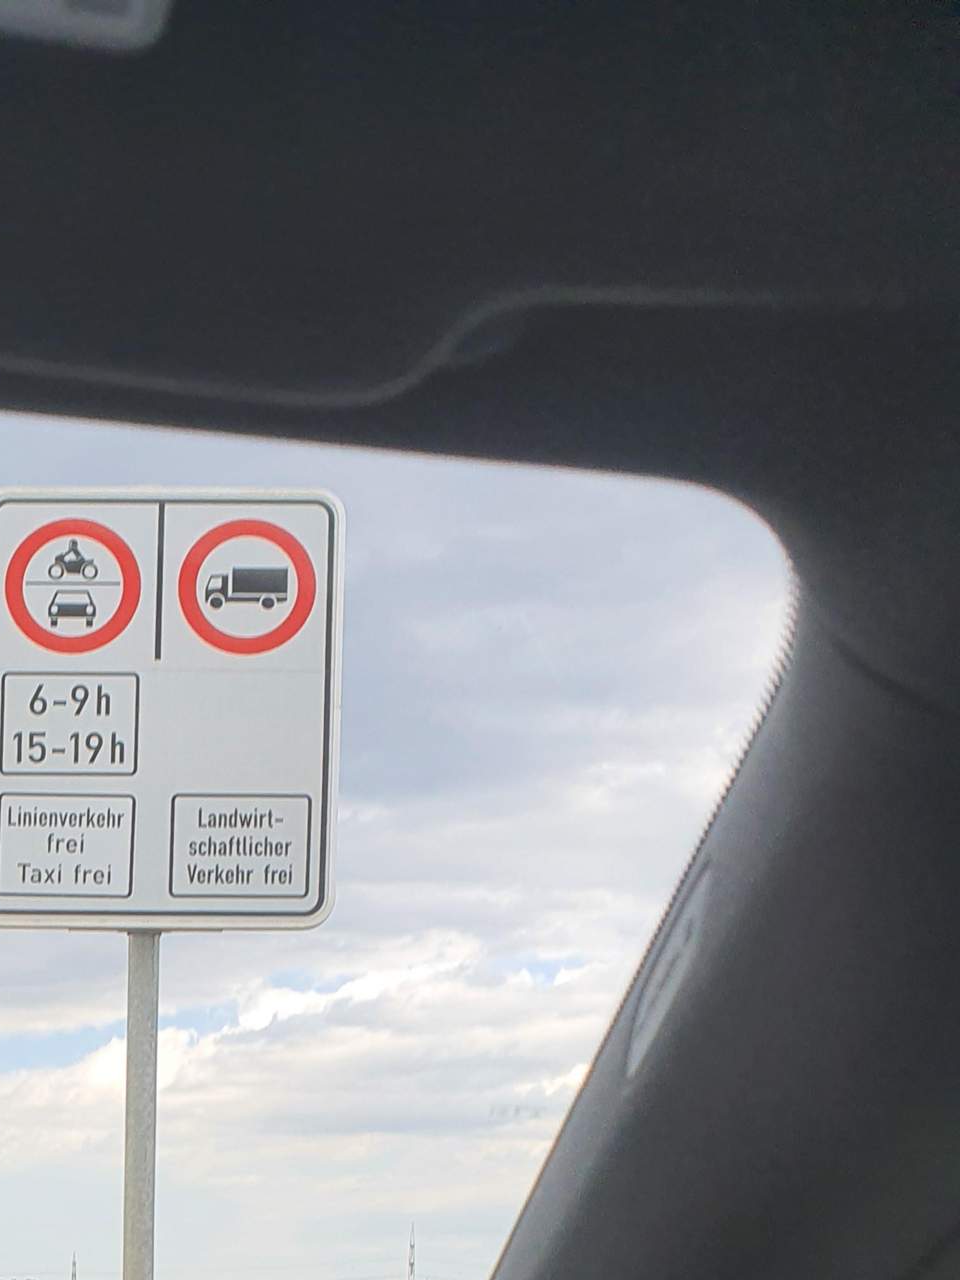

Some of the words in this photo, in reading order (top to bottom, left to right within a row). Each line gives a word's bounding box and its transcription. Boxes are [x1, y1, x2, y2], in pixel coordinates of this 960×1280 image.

[7, 806, 125, 828] Linienverkehr
[198, 808, 284, 828] Landwirt-
[47, 834, 84, 854] frei
[189, 835, 292, 857] schaftlicher
[17, 864, 62, 885] Taxi
[74, 865, 112, 885] frei
[187, 865, 254, 886] Verkehr
[263, 865, 293, 886] frei
